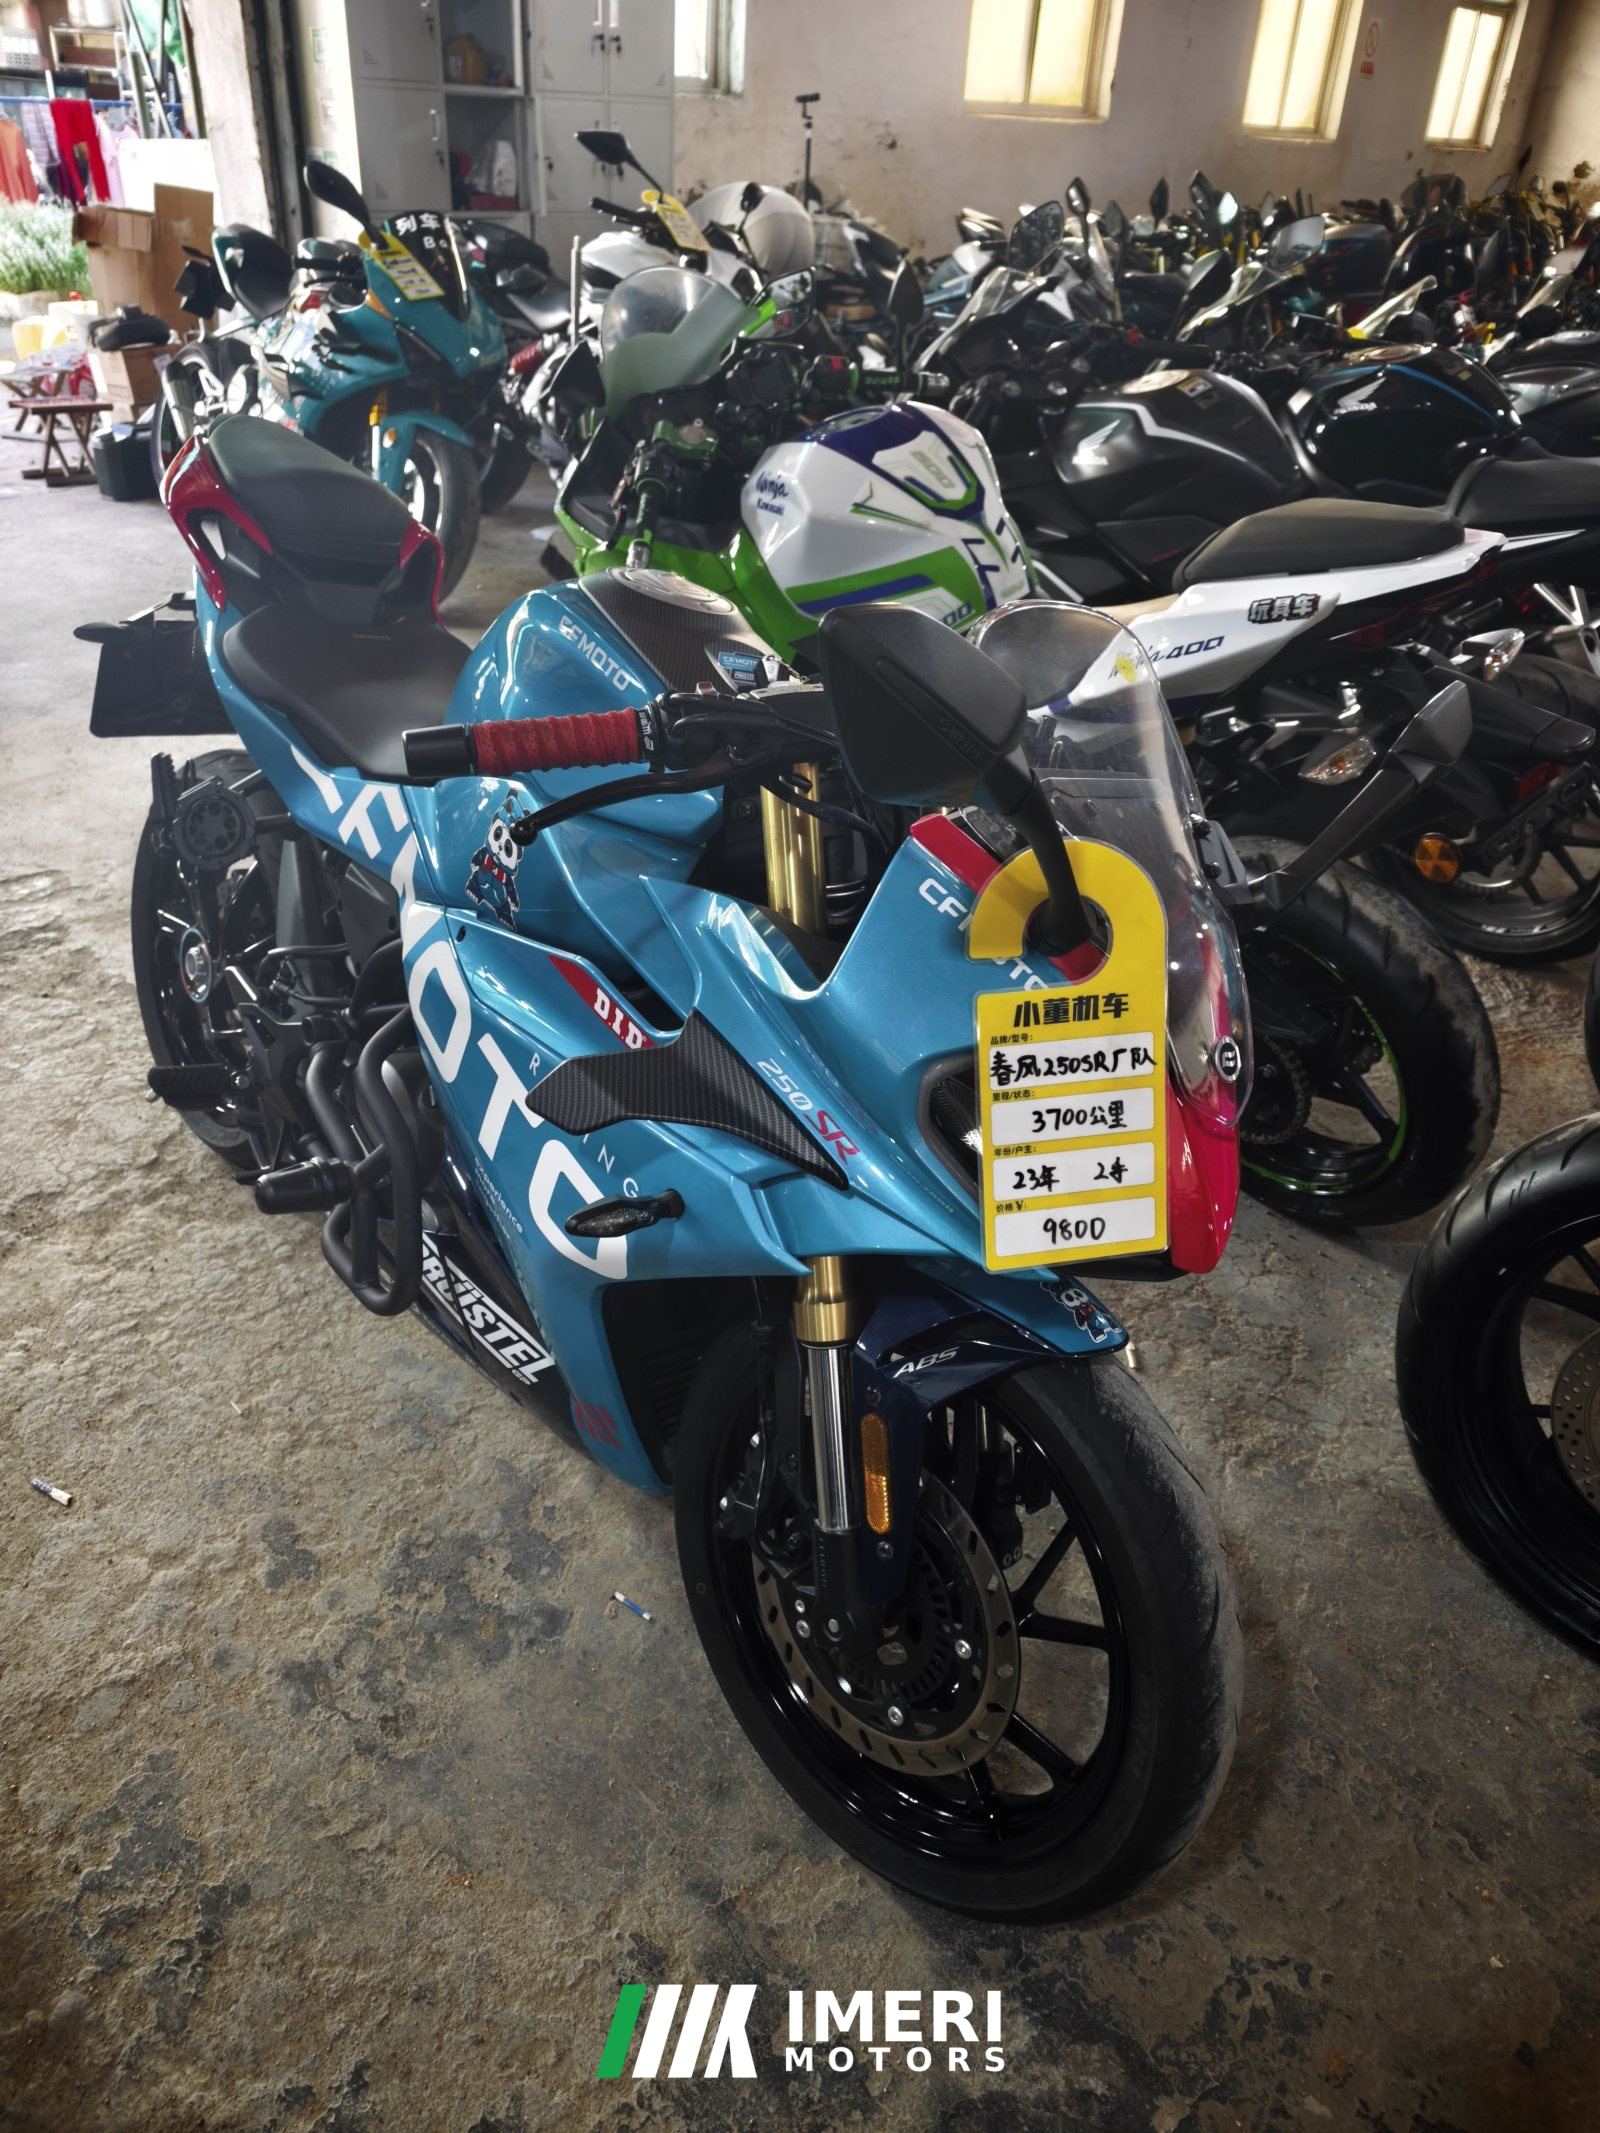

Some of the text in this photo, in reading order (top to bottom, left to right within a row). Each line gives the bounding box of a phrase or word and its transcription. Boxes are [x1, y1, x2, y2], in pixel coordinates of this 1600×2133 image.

[943, 603, 972, 626] 00
[1249, 594, 1319, 622] 玩具车
[558, 615, 631, 691] CFMOTO
[722, 655, 759, 667] CFMOT
[1165, 635, 1225, 660] 400
[1013, 992, 1129, 1028] 小董机车
[1032, 1099, 1128, 1133] 3700公里
[1012, 1164, 1060, 1192] 23年
[1043, 1217, 1106, 1245] 9800
[893, 1346, 959, 1378] ABS
